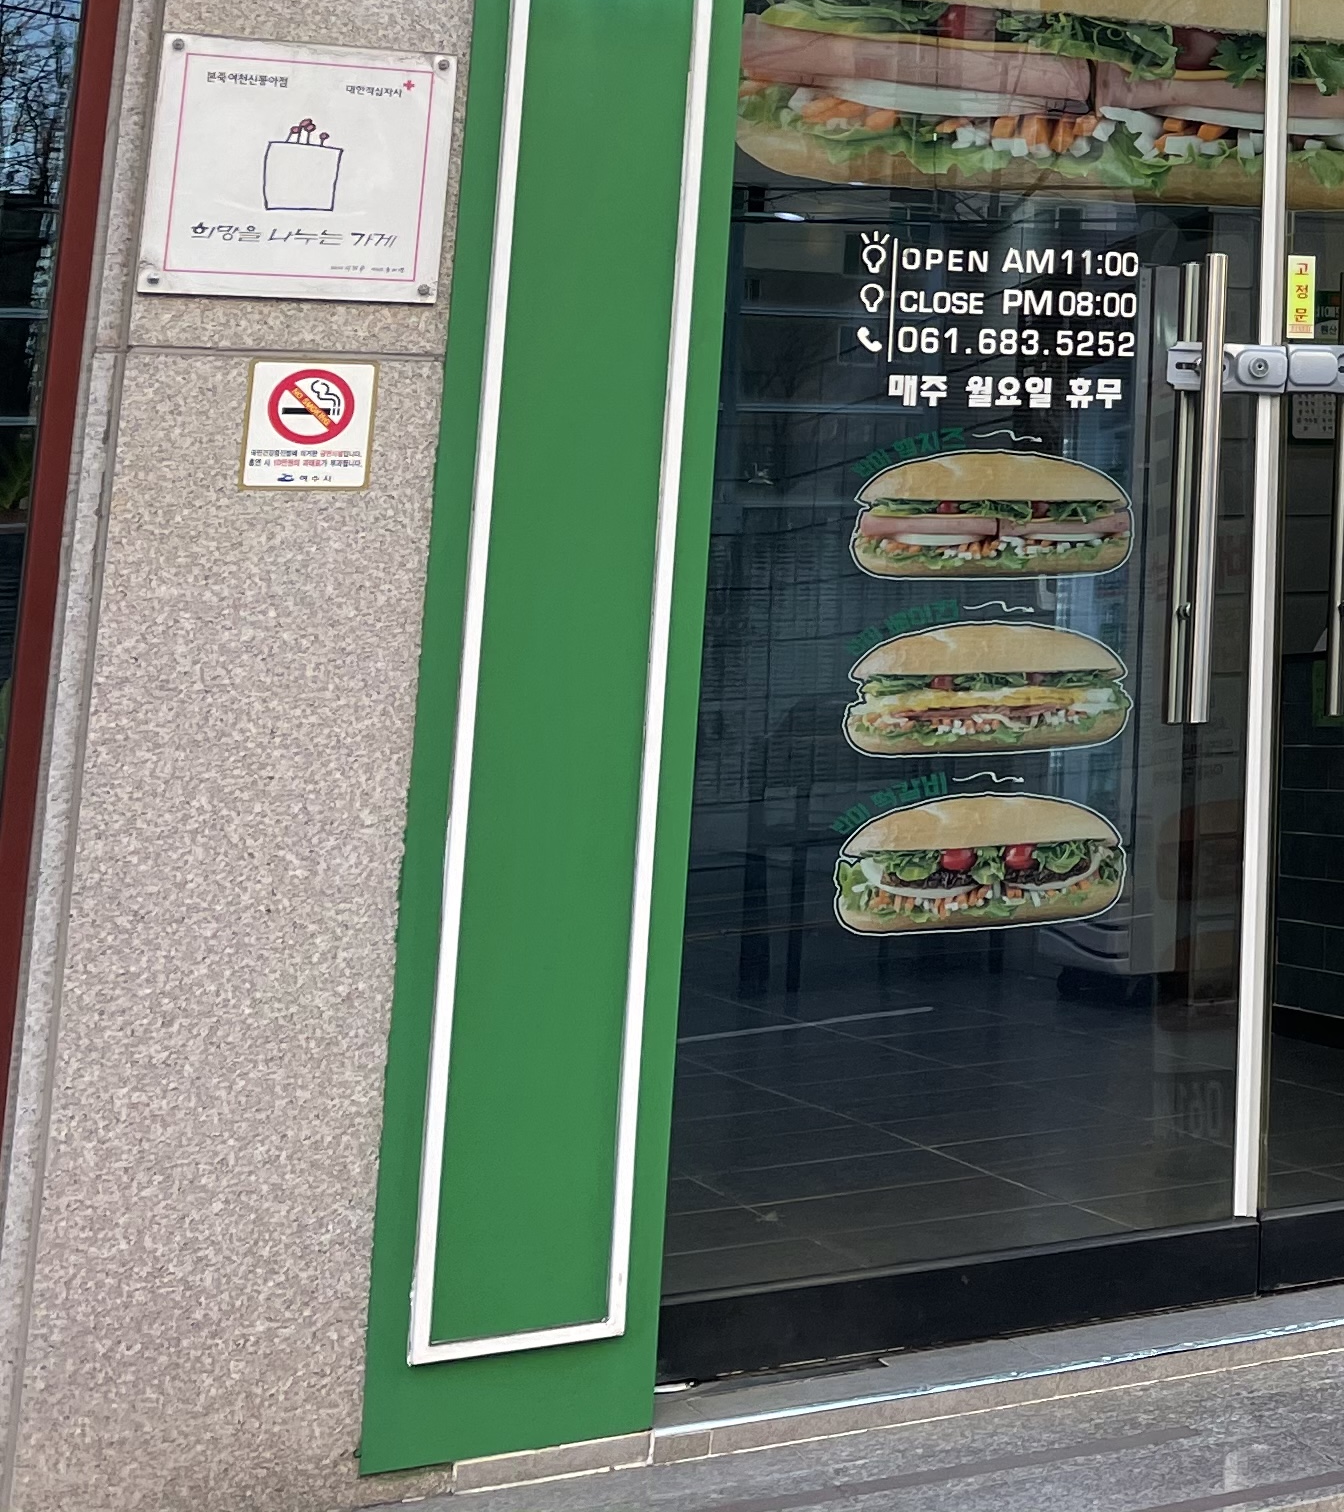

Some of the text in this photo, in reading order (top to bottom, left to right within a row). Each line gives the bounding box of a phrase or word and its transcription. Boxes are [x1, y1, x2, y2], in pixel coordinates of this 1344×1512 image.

[190, 222, 398, 248] 희망을 나누는 가게
[902, 248, 989, 273] OPEN
[900, 290, 984, 315] CLOSE
[898, 326, 1135, 357] 061.683.5252
[888, 374, 1122, 409] 매주 월요일 휴무
